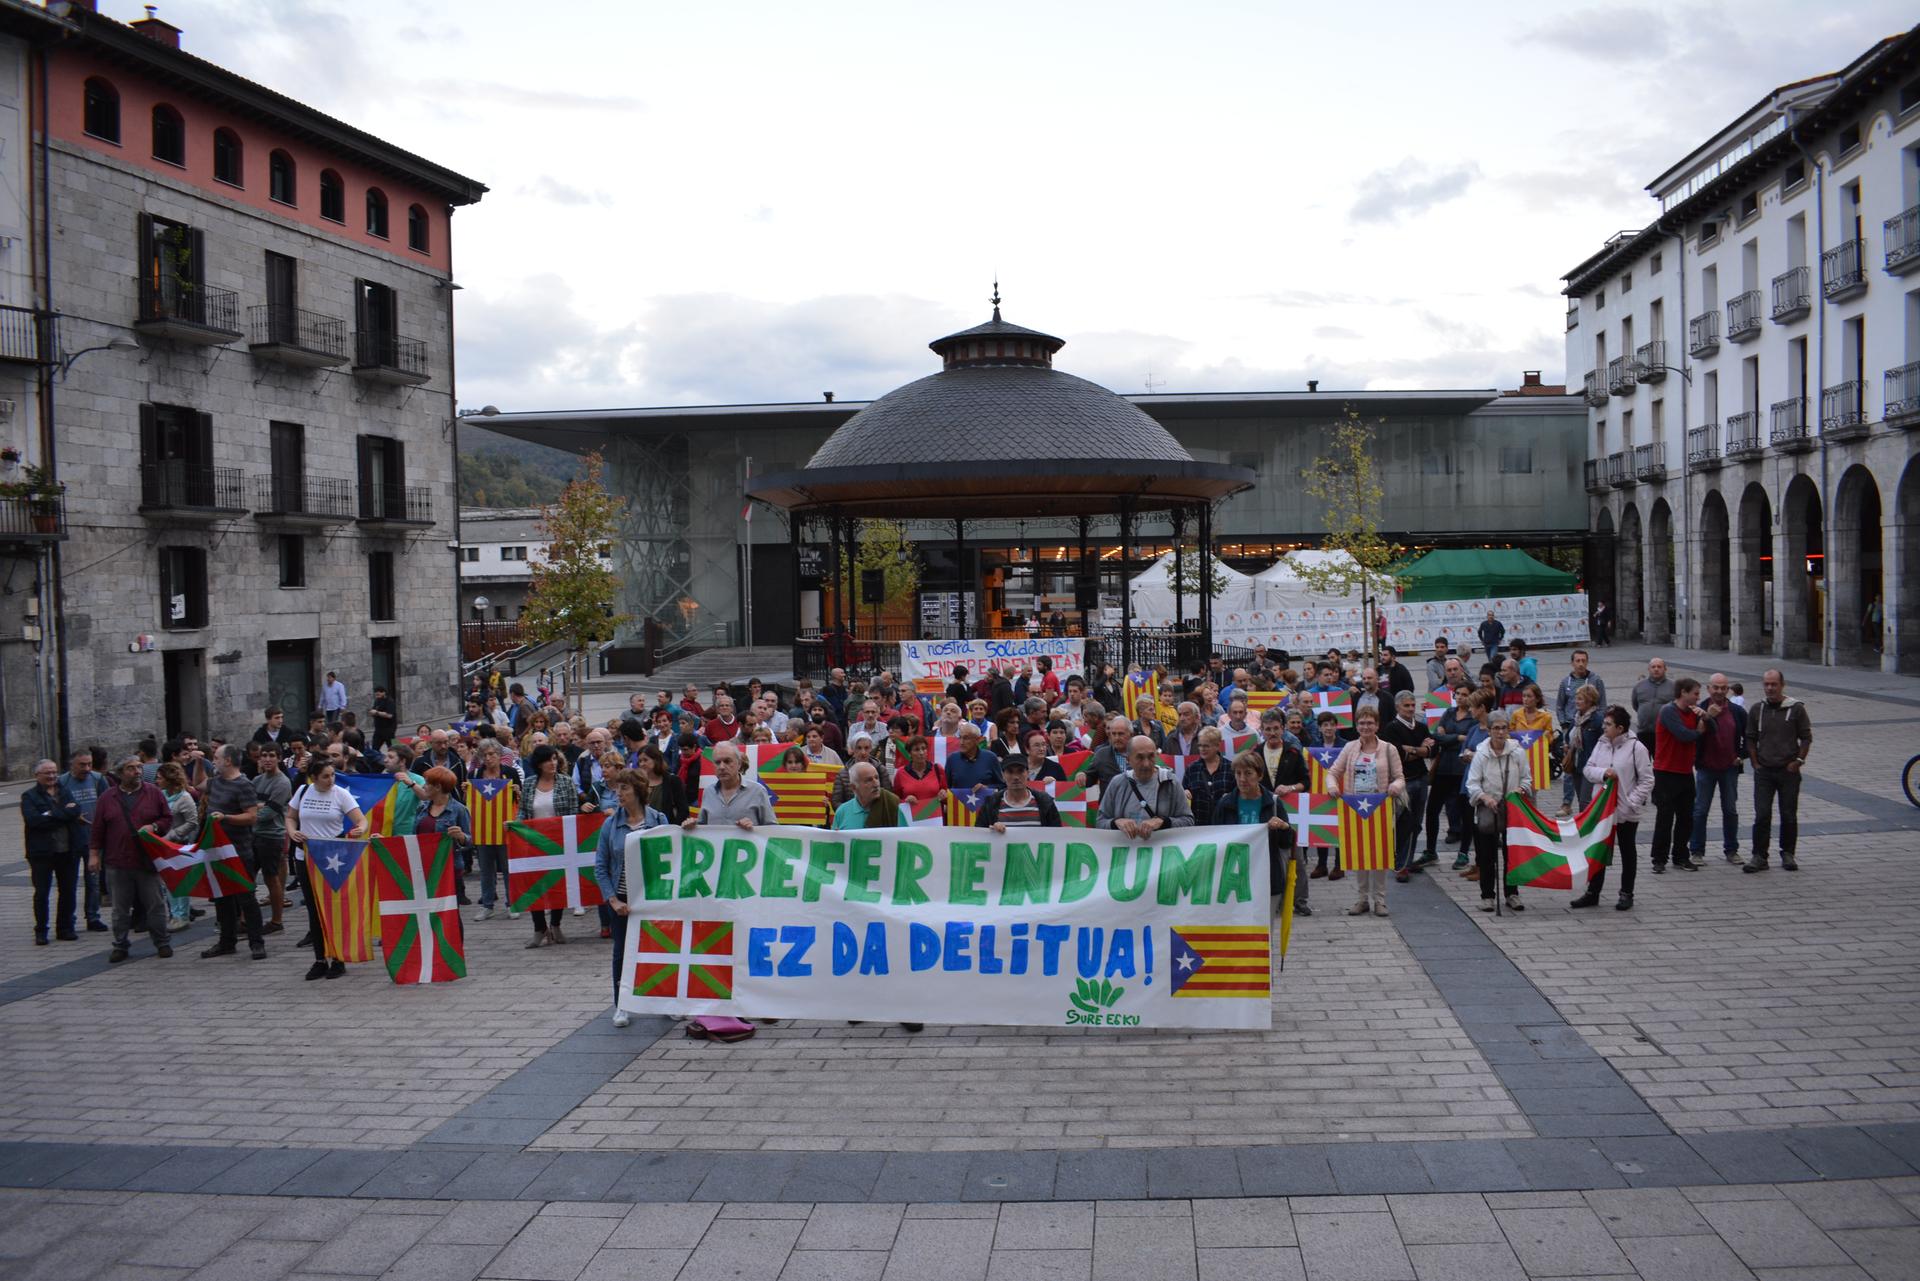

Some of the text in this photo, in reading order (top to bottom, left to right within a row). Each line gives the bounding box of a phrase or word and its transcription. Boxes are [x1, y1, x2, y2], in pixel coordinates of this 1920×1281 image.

[927, 639, 975, 656] nostra
[748, 925, 816, 977] EZ
[833, 921, 889, 976] DA
